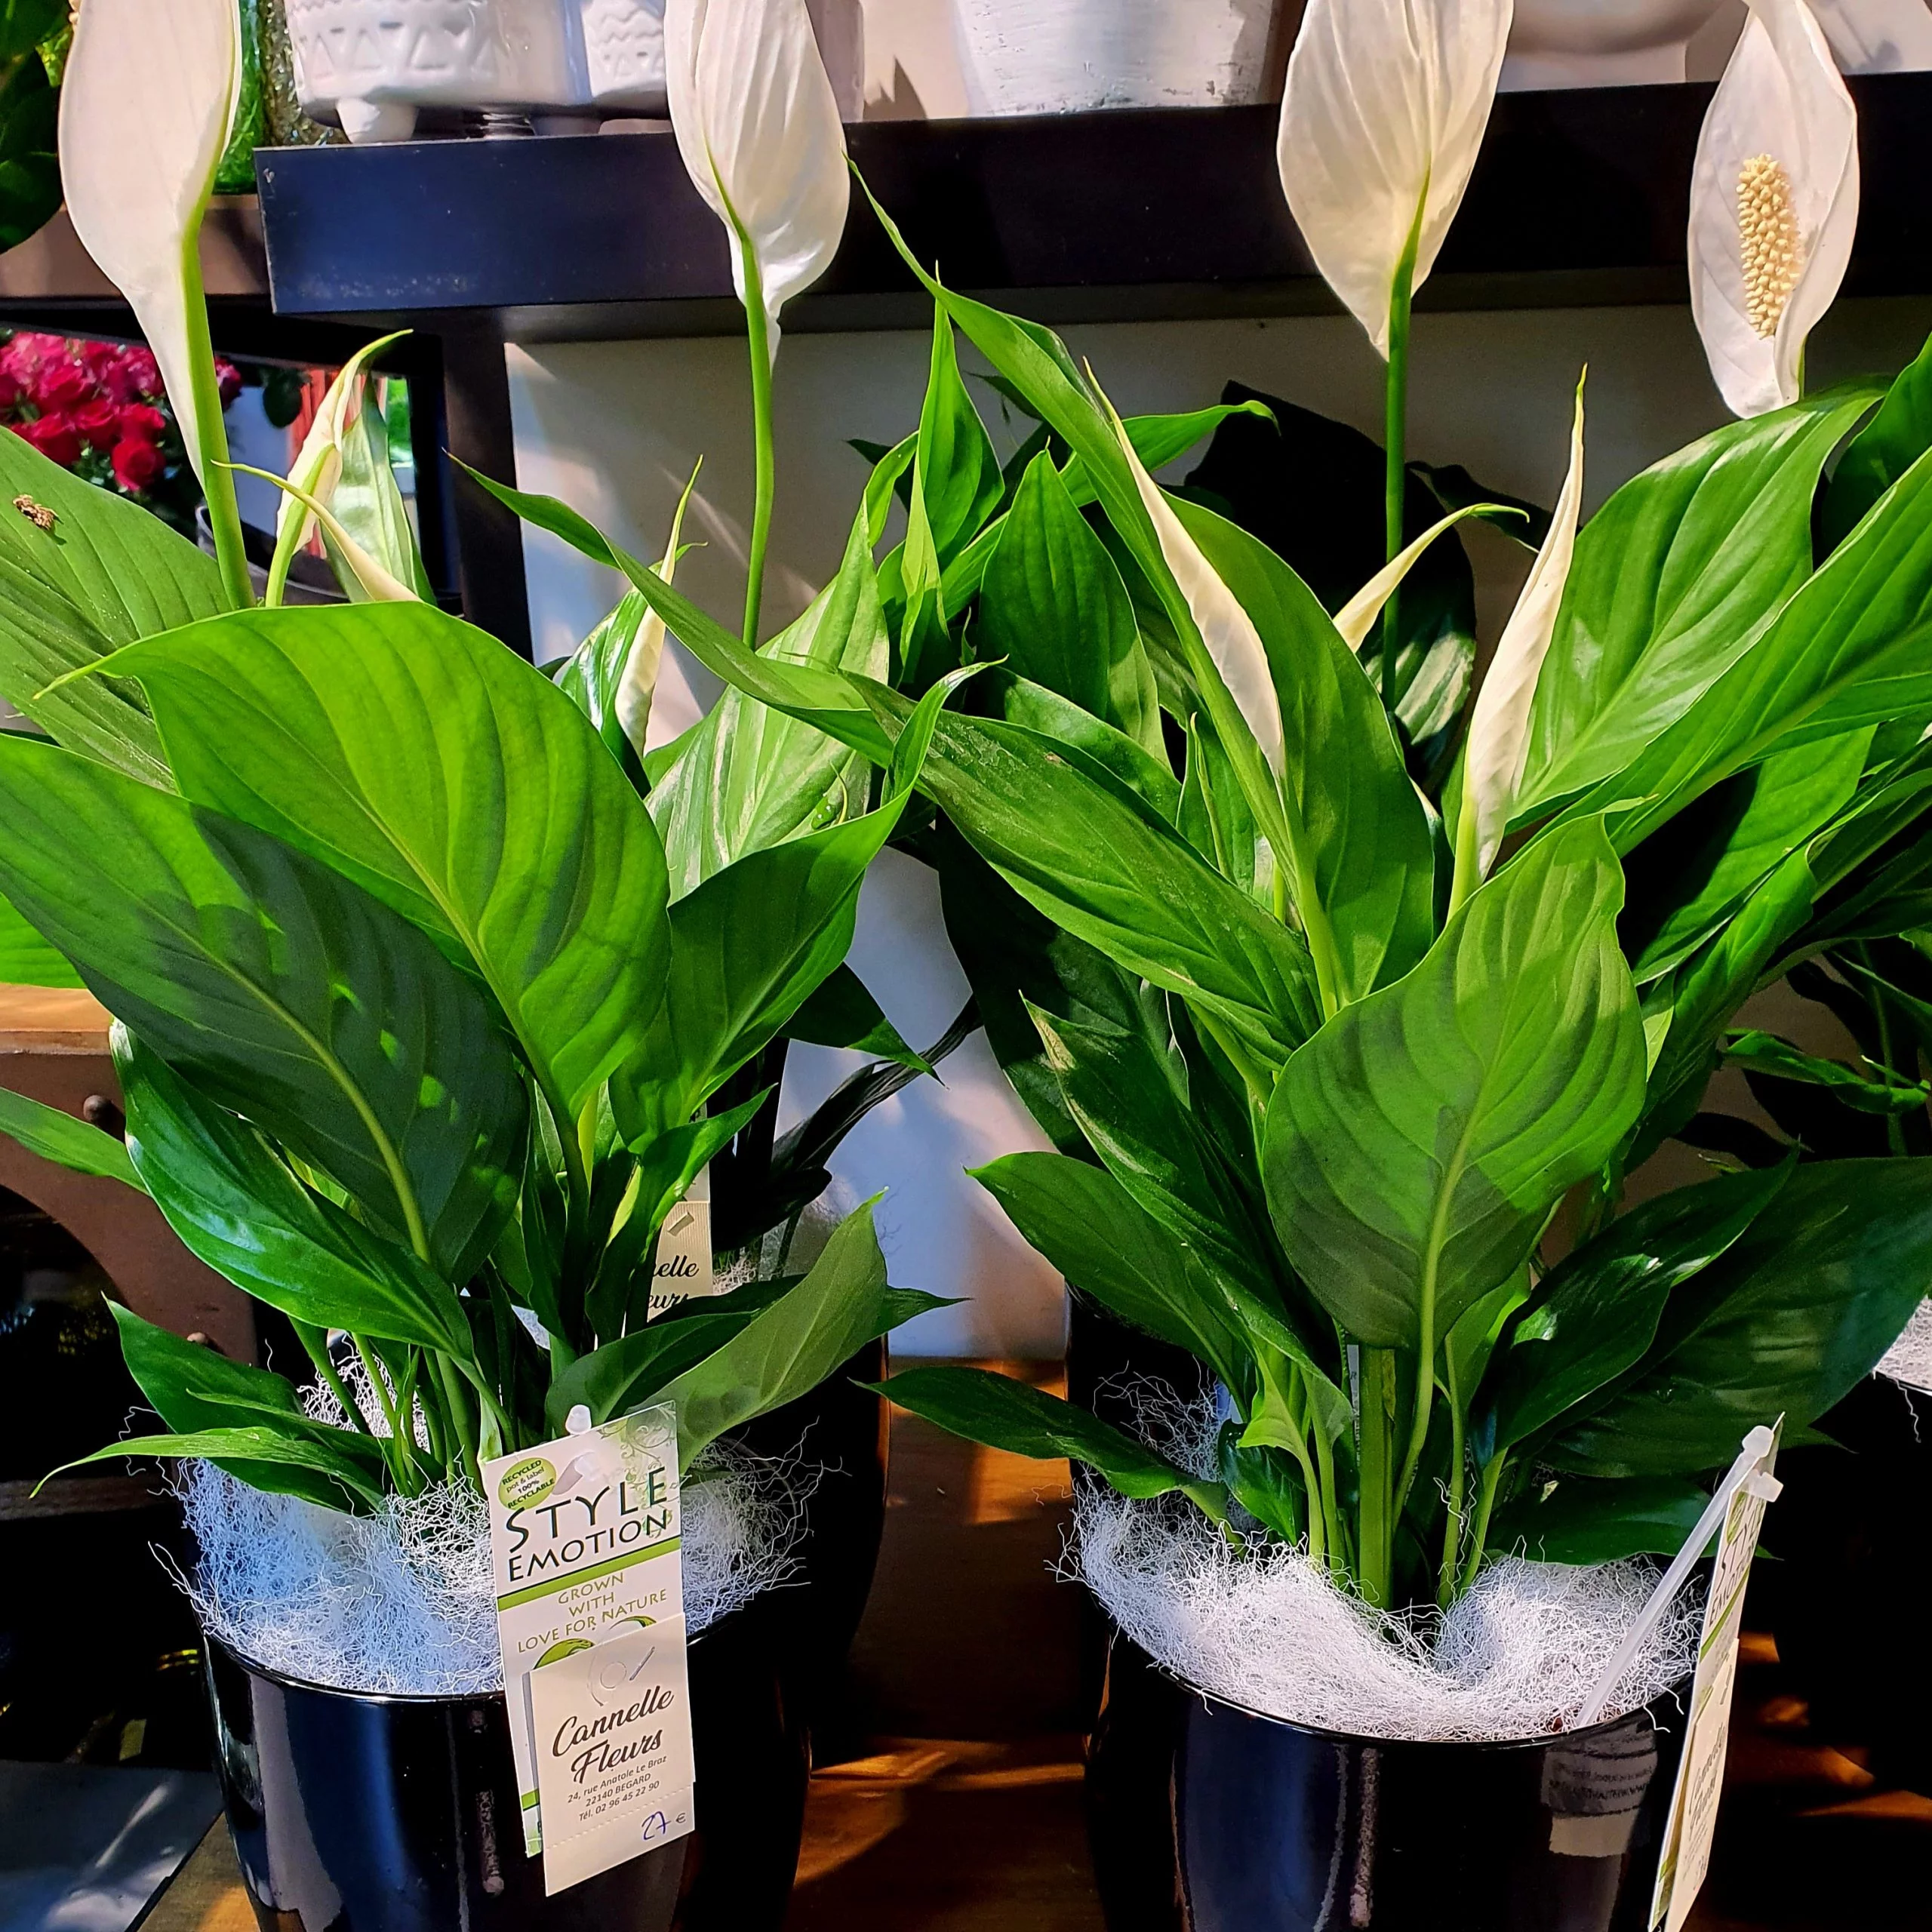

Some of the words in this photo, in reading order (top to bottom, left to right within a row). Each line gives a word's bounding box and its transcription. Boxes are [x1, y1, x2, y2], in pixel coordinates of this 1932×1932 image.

[653, 1255, 699, 1277] elle
[502, 1460, 542, 1485] RECYCLED
[506, 1481, 519, 1494] pot
[526, 1466, 544, 1480] label
[518, 1480, 540, 1494] 100%
[506, 1466, 667, 1553] STYLE
[507, 1478, 555, 1509] RECYCLABLE
[509, 1509, 667, 1582] EMOTION
[558, 1572, 623, 1604] GROWN
[569, 1592, 614, 1617] WITH
[518, 1628, 559, 1653] LOVE
[566, 1616, 596, 1635] FOR
[602, 1589, 667, 1623] NATURE
[552, 1685, 674, 1757] Cannelle
[571, 1730, 663, 1784] Fleurs
[568, 1792, 581, 1803] 24,
[583, 1784, 598, 1796] rue
[600, 1769, 634, 1789] Anatole
[636, 1764, 645, 1773] Le
[648, 1756, 666, 1768] Braz
[586, 1789, 613, 1807] 22140
[615, 1773, 651, 1794] BEGARD
[579, 1809, 592, 1821] Tél.
[595, 1804, 606, 1814] 02
[609, 1798, 620, 1808] 96
[622, 1792, 632, 1801] 45
[635, 1786, 646, 1797] 22
[648, 1780, 660, 1792] 90
[641, 1810, 672, 1841] 27
[675, 1812, 686, 1825] €
